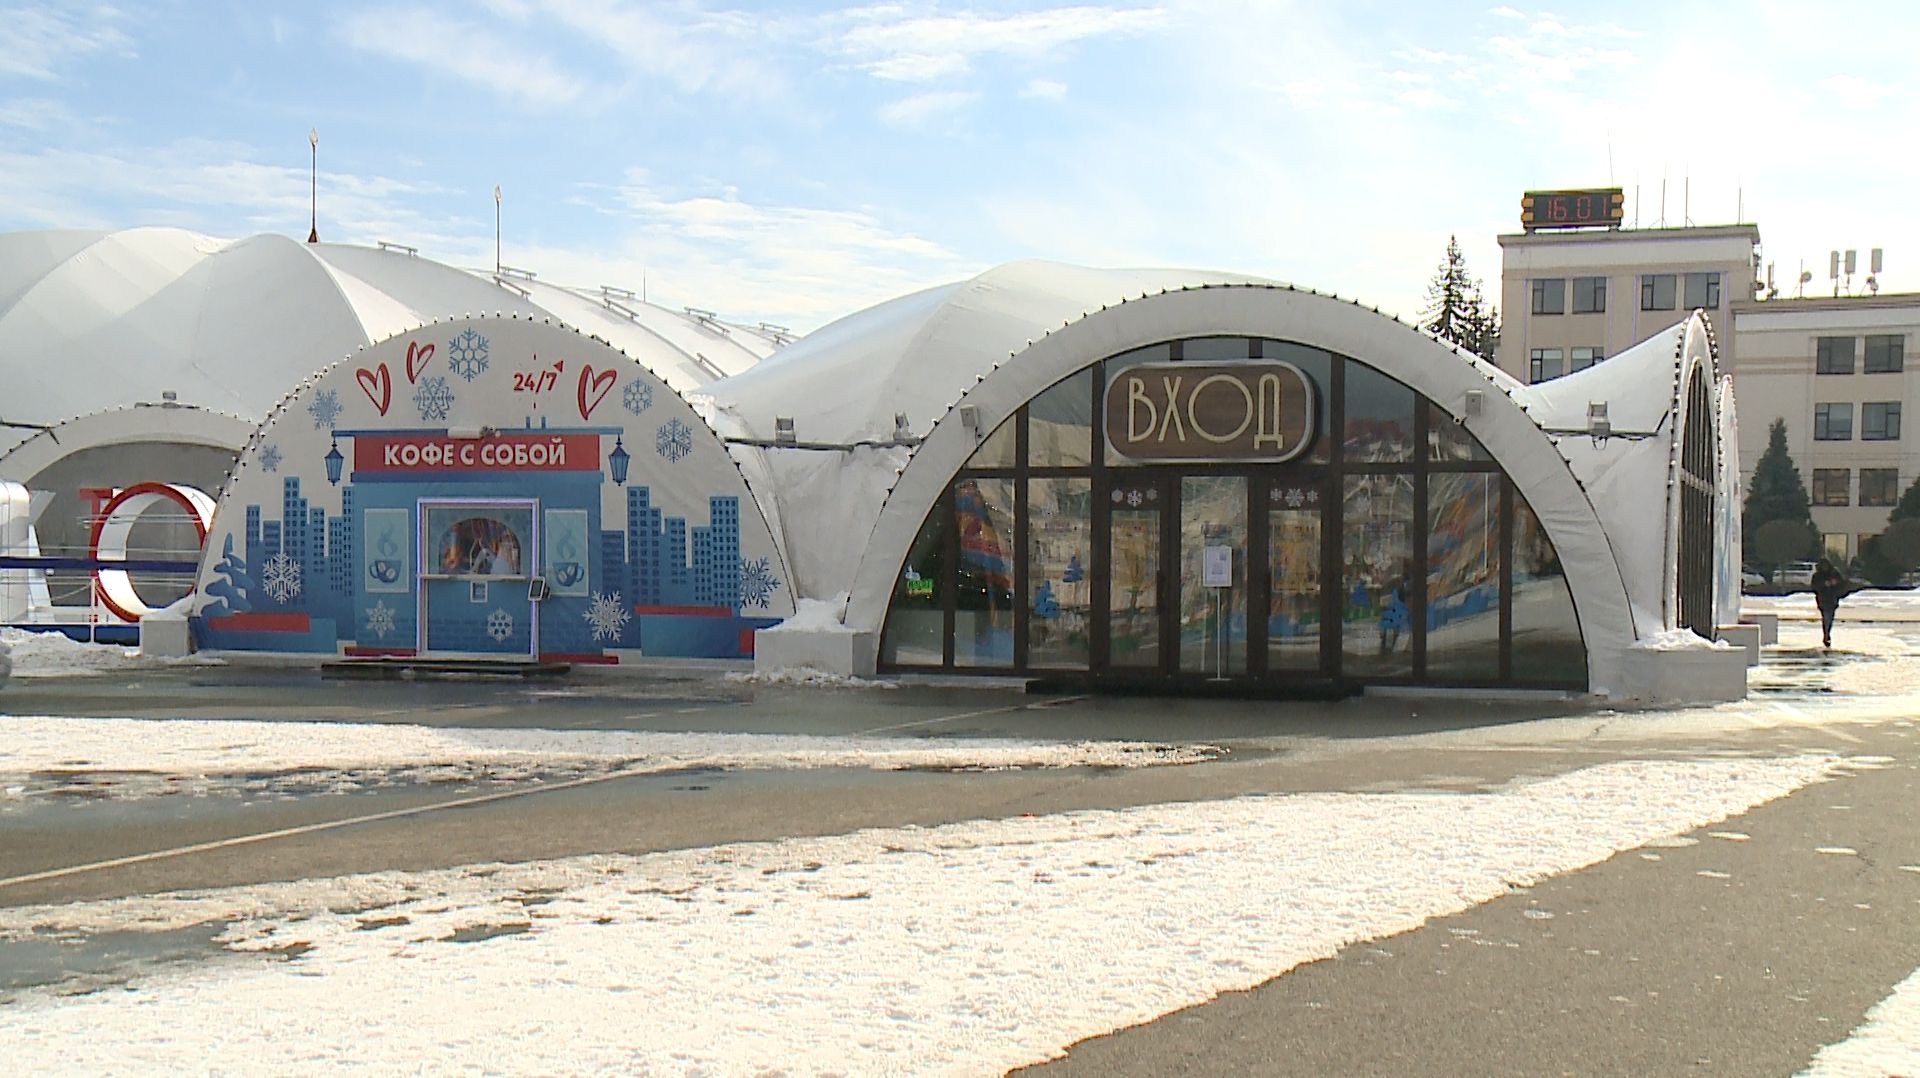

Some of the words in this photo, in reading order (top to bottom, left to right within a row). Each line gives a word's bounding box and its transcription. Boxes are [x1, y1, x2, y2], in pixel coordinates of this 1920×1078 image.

[513, 371, 557, 393] 24/7
[1128, 373, 1284, 449] ВХОД
[384, 442, 454, 466] КОФЕ
[460, 444, 474, 465] С
[480, 437, 566, 466] СОБОЙ
